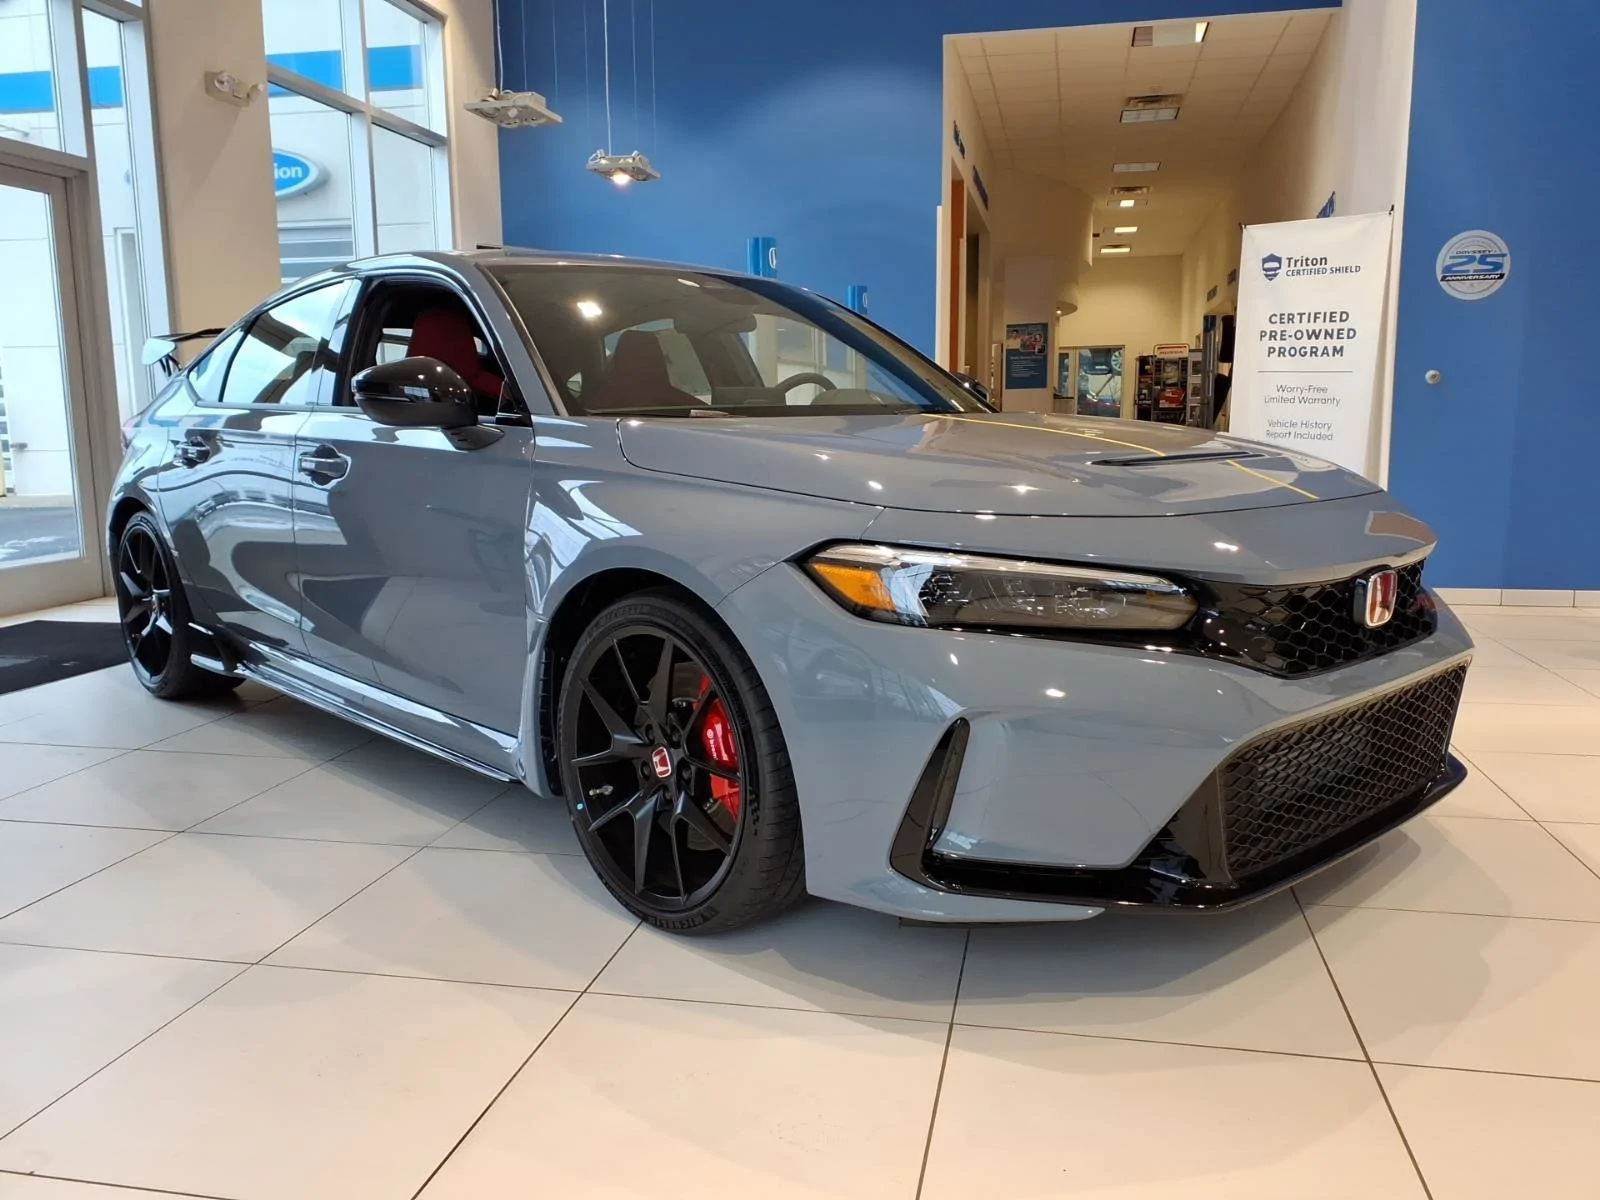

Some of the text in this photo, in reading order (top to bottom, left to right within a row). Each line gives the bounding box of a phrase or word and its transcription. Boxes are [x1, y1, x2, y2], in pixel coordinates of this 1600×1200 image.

[1286, 255, 1328, 268] Triton
[1442, 253, 1507, 274] 25
[1286, 265, 1361, 277] CERTIFIED SHIELD
[1268, 311, 1349, 325] CERTIFIED
[1259, 328, 1357, 341] PRE-OWNED
[1267, 345, 1344, 357] PROGRAM
[1276, 384, 1328, 394] Worry-Free
[1264, 396, 1341, 407] Limited Warranty
[1267, 419, 1332, 431] Vehicle History
[1266, 429, 1333, 441] Report Included
